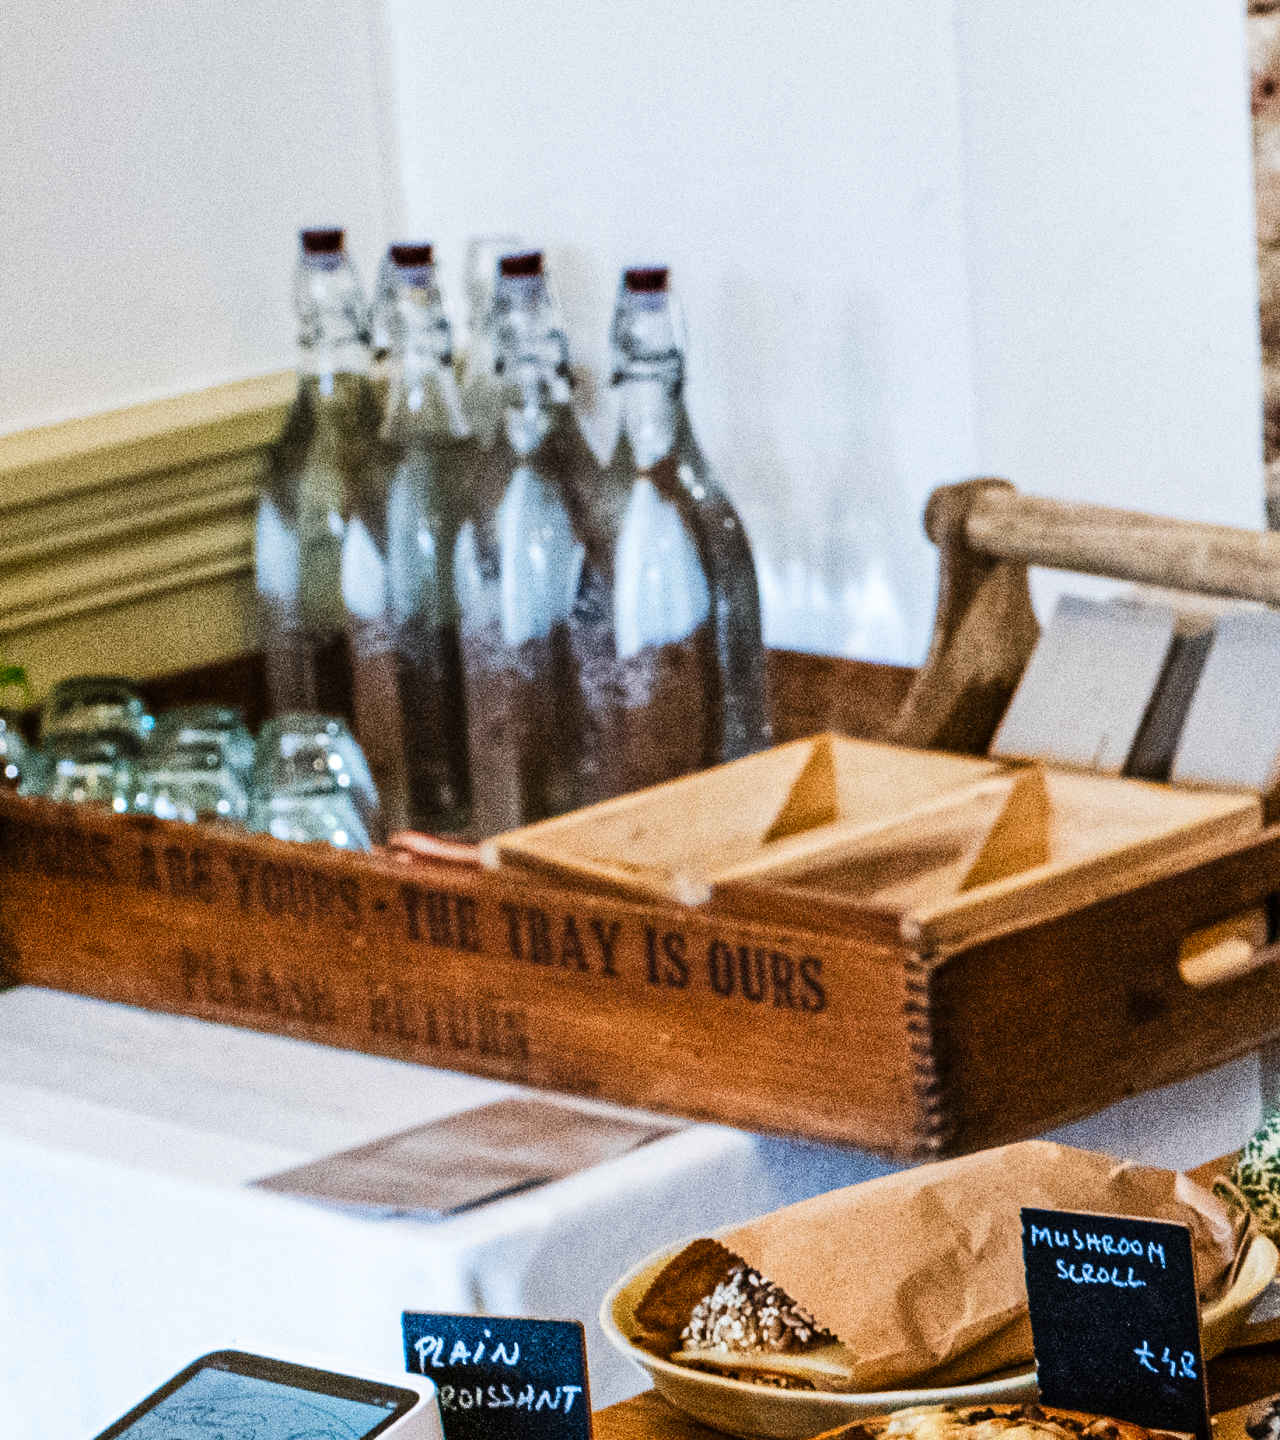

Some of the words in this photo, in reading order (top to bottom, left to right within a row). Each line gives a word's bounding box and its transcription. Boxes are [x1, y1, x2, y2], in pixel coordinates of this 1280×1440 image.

[401, 882, 482, 953] THE
[502, 903, 620, 977] TRAY
[644, 922, 690, 989] IS
[706, 937, 827, 1013] OURS
[1031, 1224, 1166, 1269] MUSHROOM
[1055, 1259, 1146, 1288] SCROLL
[439, 1384, 582, 1414] ROISSANT
